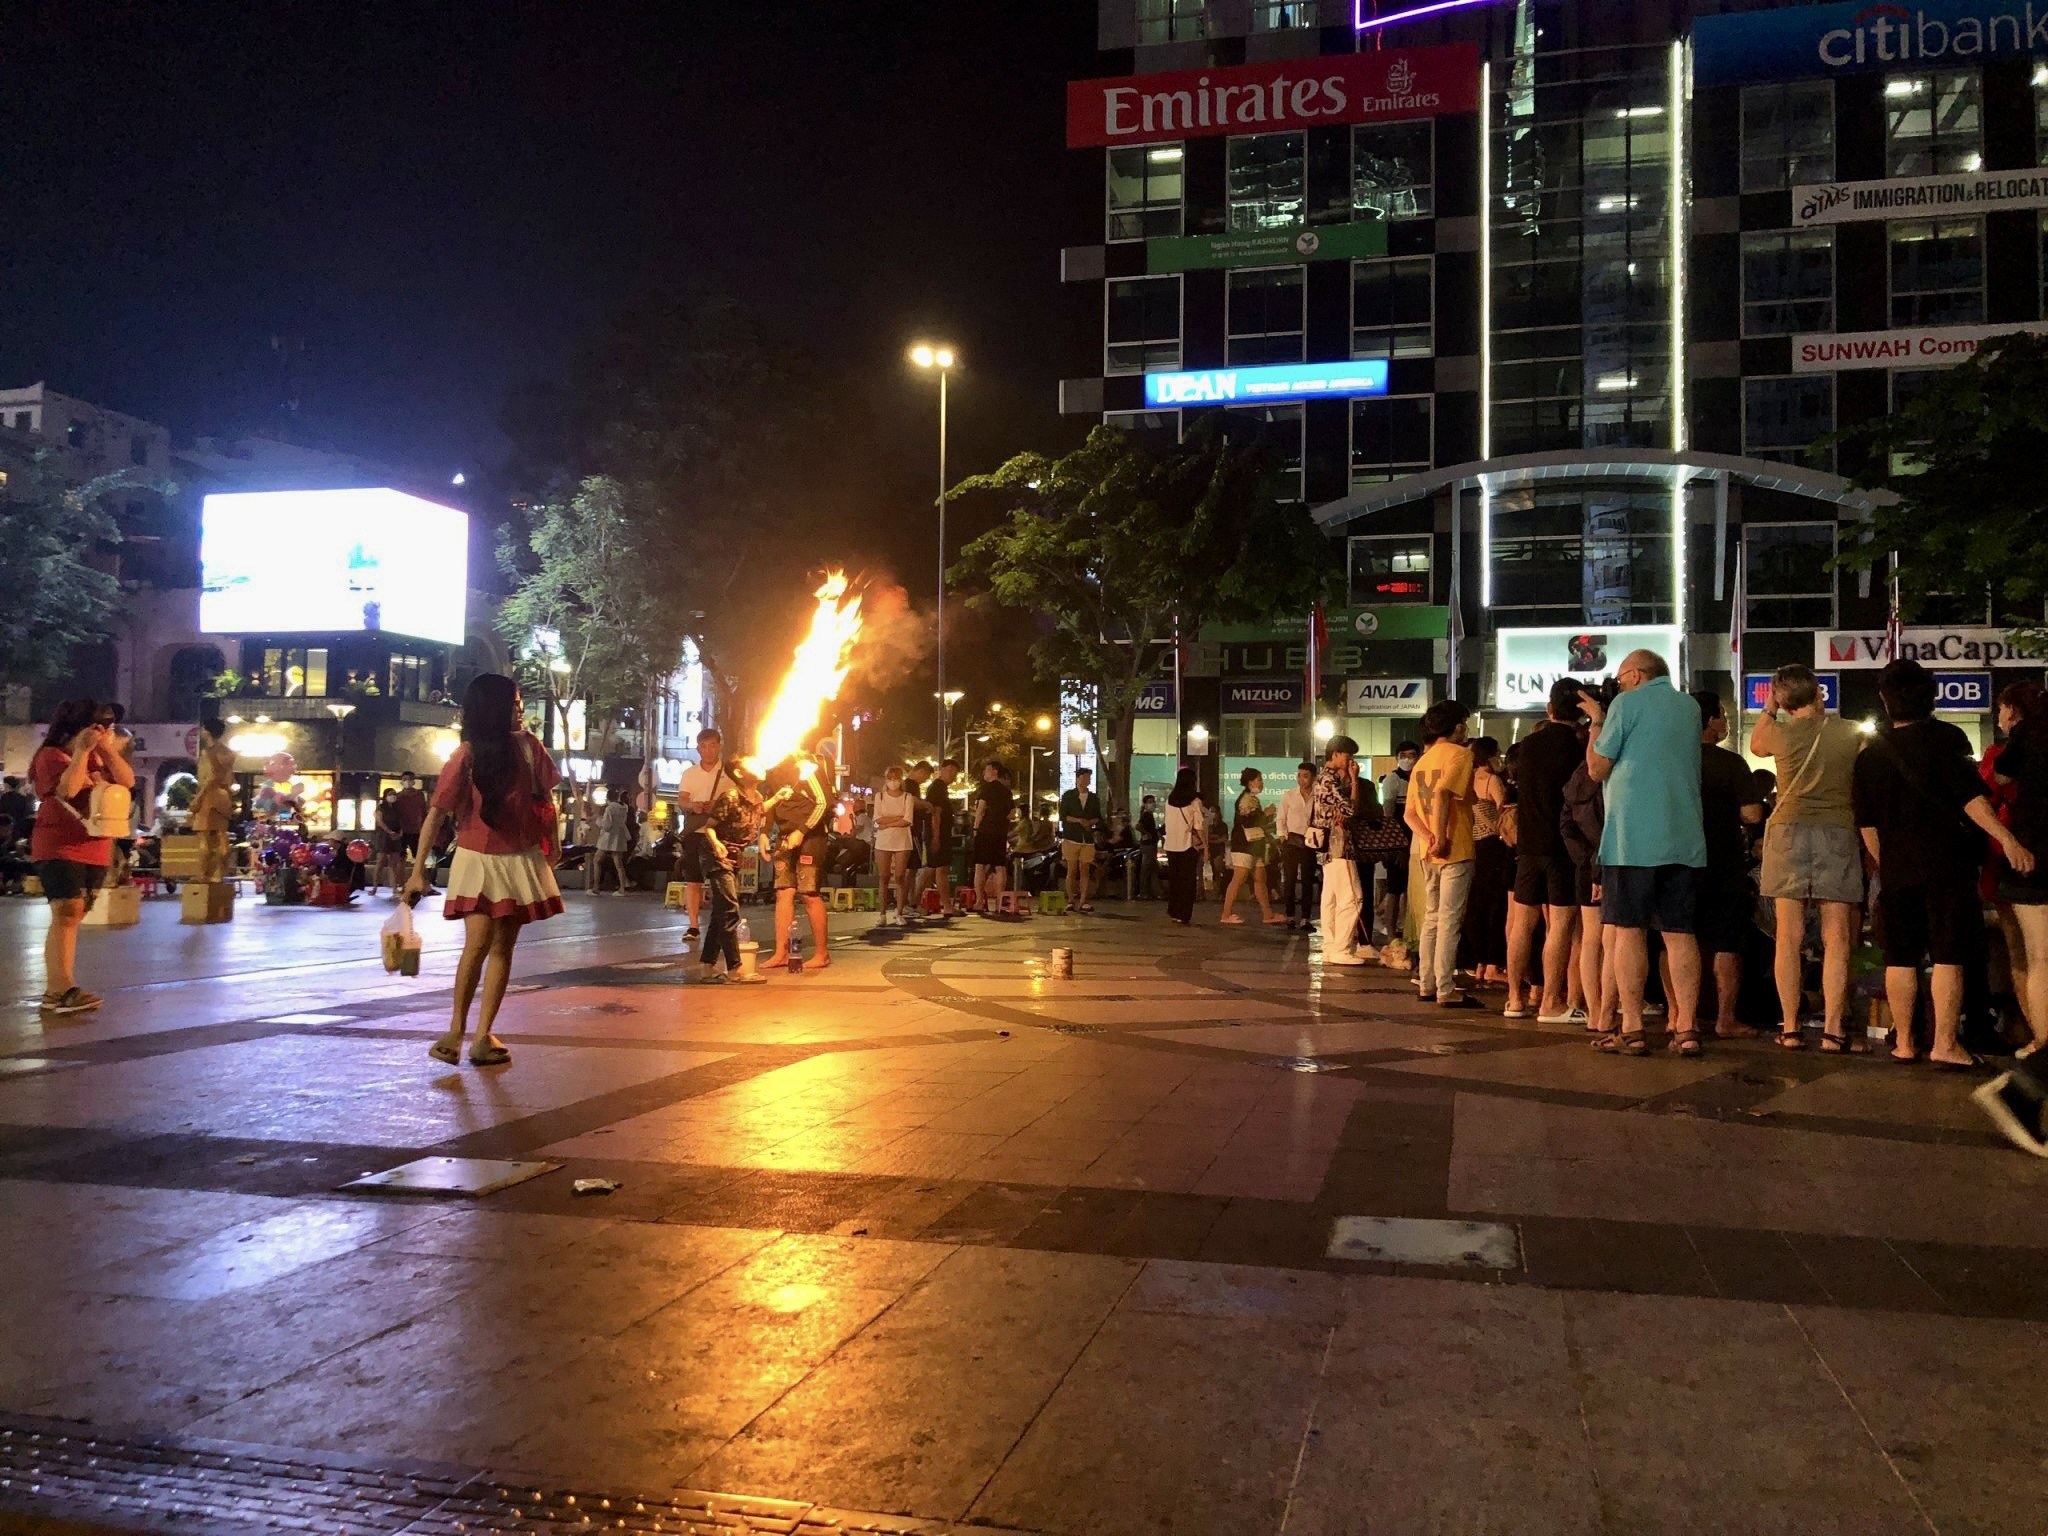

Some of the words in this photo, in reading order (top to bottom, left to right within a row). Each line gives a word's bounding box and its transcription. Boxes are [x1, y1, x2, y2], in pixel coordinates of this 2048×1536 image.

[1819, 0, 2048, 66] citibank
[1104, 77, 1347, 135] Emirates
[1362, 92, 1440, 113] Emirates
[1853, 182, 1965, 210] IMMIGRATION
[1802, 339, 1911, 362] SUNWAH
[1919, 338, 1977, 355] Com
[1231, 688, 1292, 701] MIZUHO
[1358, 684, 1398, 699] ANA
[1506, 672, 1544, 694] SUN
